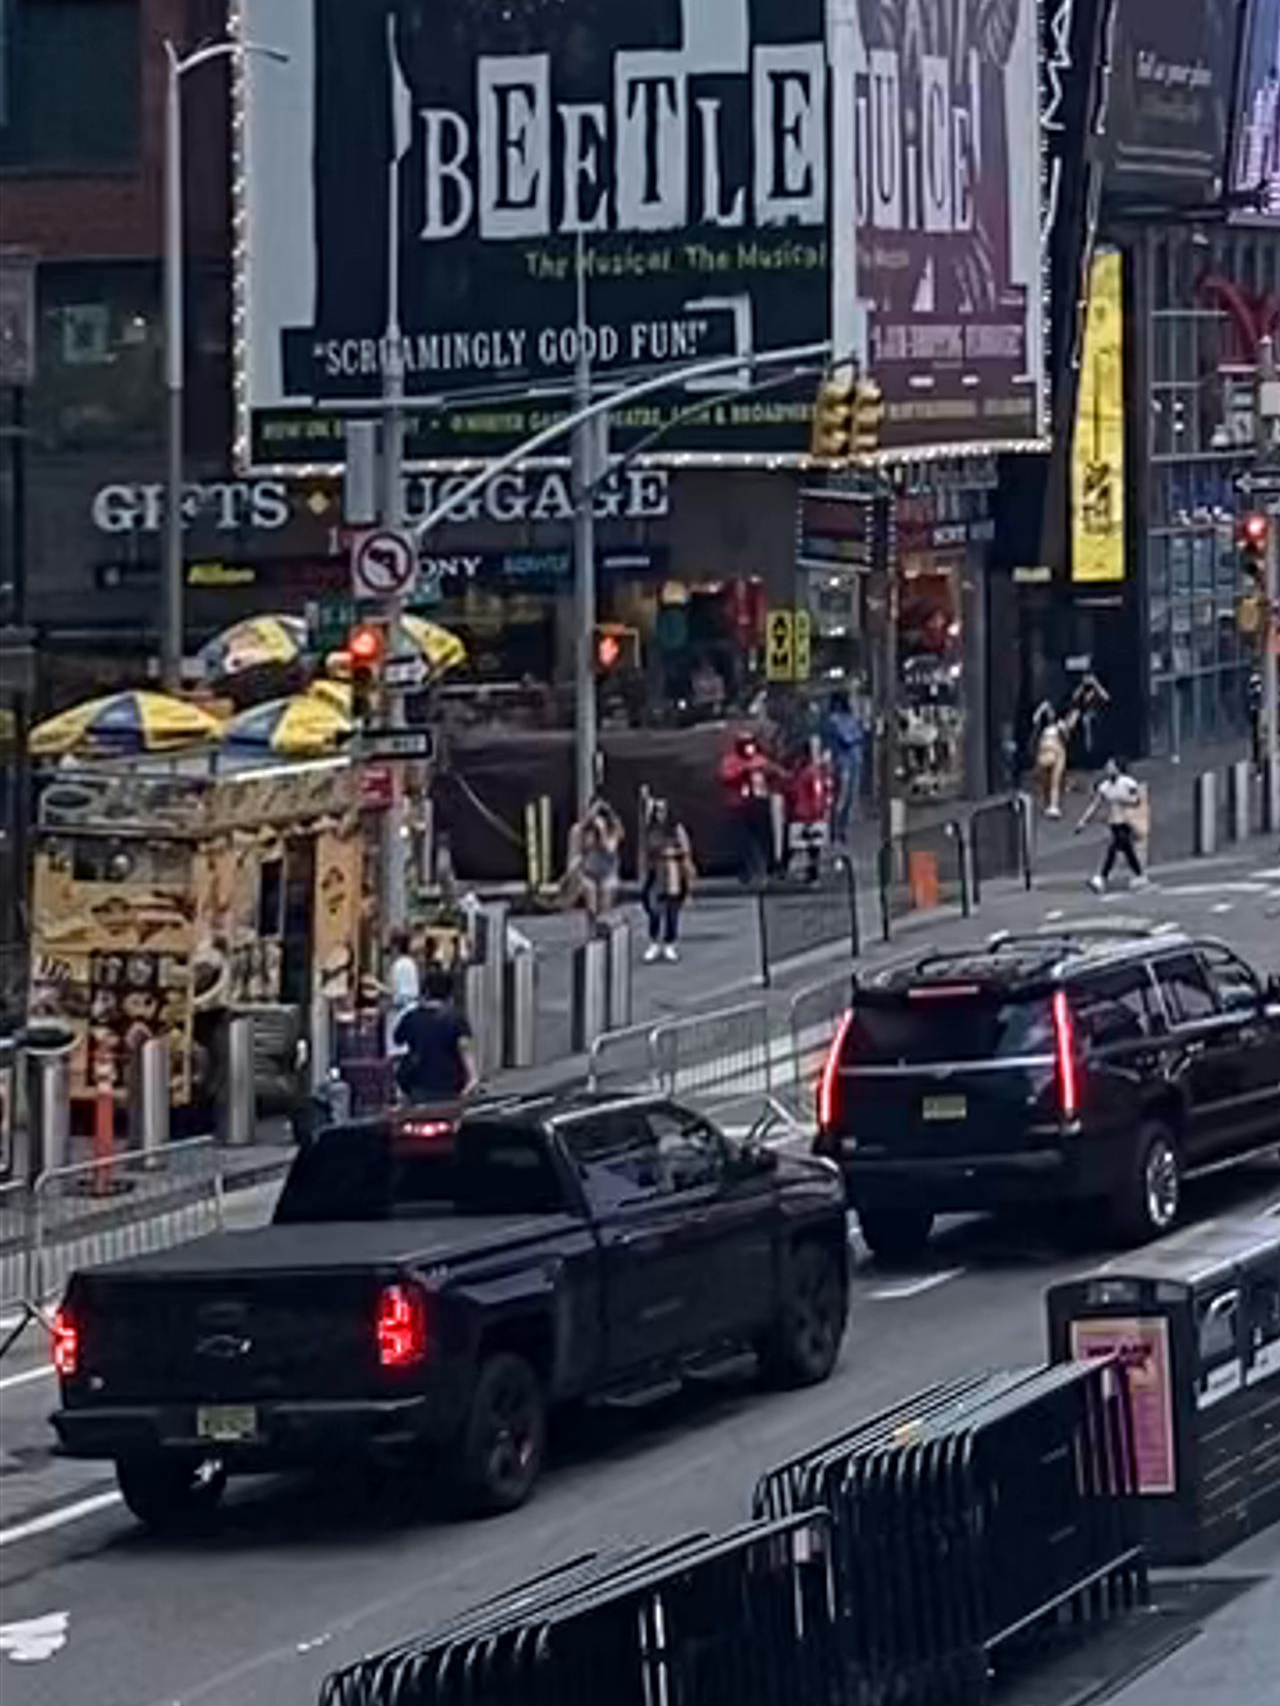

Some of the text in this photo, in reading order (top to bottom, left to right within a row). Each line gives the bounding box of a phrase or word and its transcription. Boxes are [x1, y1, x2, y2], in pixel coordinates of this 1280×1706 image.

[419, 70, 819, 241] BEETLE
[400, 468, 669, 520] UGGAGE
[417, 555, 483, 578] ONY
